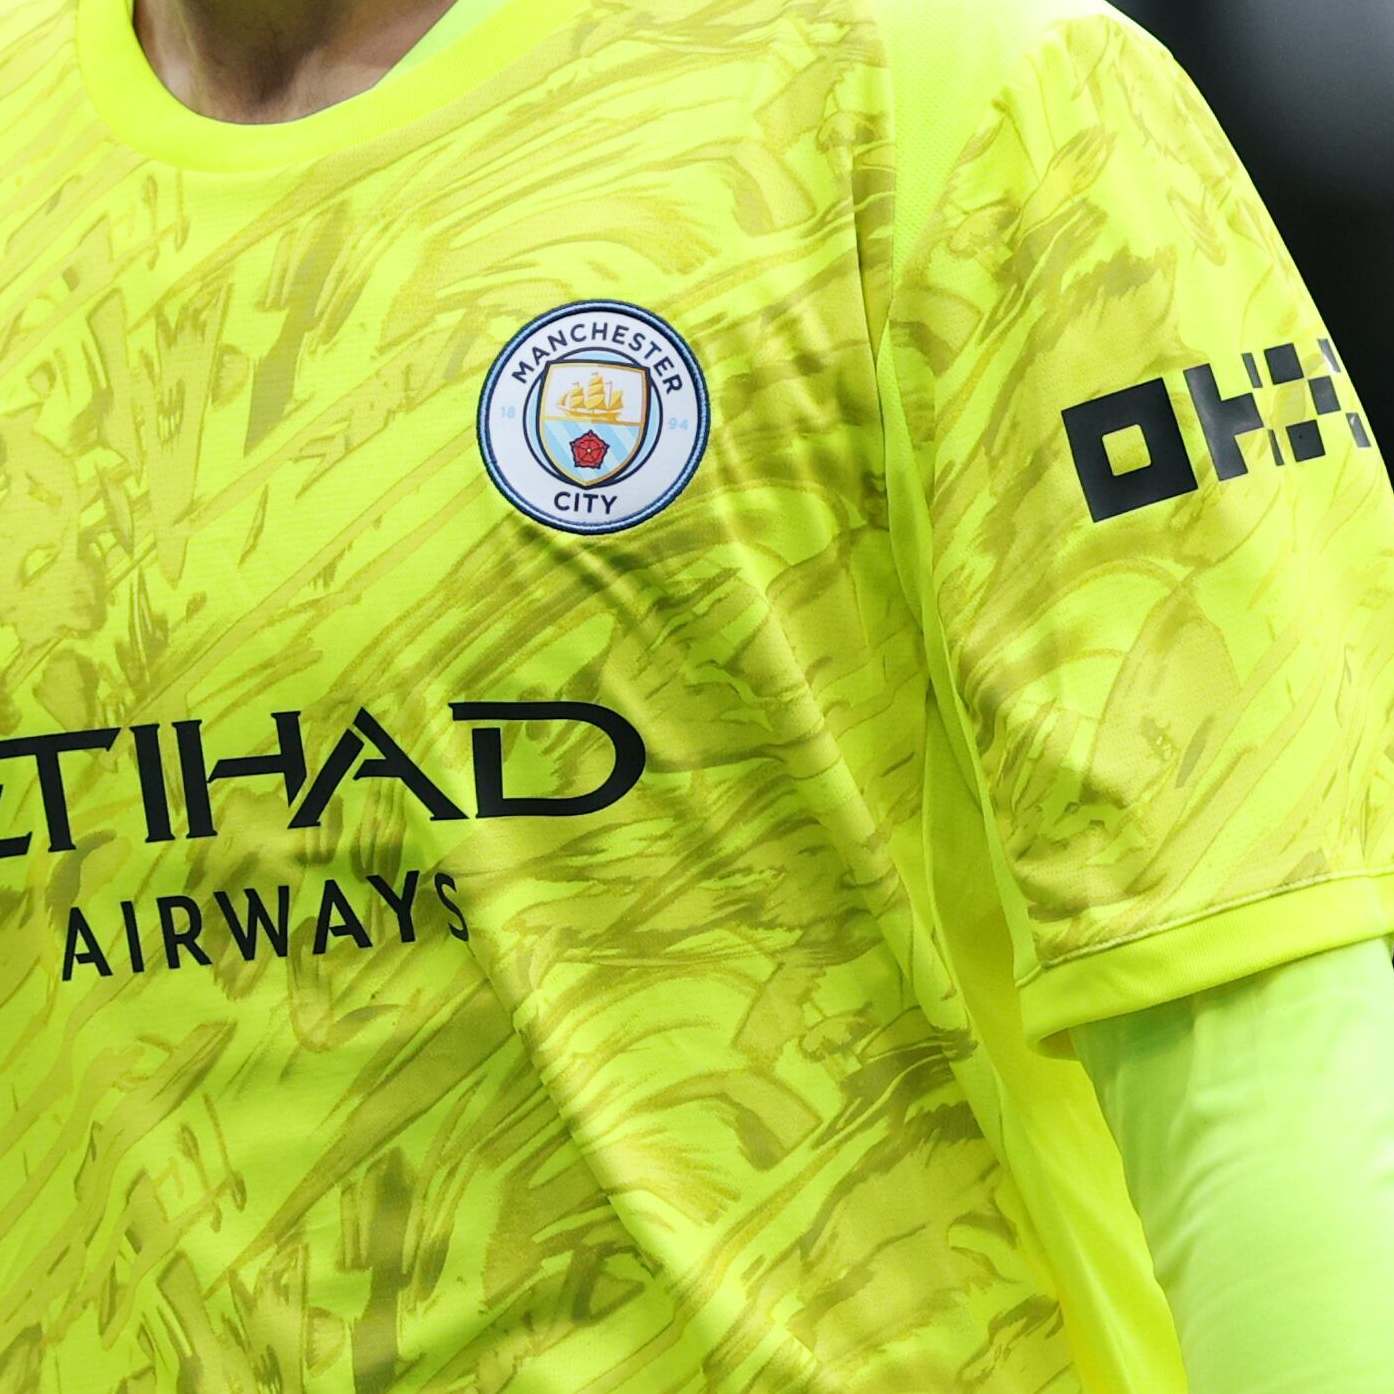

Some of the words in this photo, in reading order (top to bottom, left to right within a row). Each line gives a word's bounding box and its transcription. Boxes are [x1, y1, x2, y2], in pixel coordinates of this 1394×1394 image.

[511, 322, 683, 395] MANCHESTER
[500, 406, 516, 419] 18
[668, 417, 688, 431] 94
[553, 491, 618, 515] CITY
[62, 869, 470, 982] AIRWAYS
